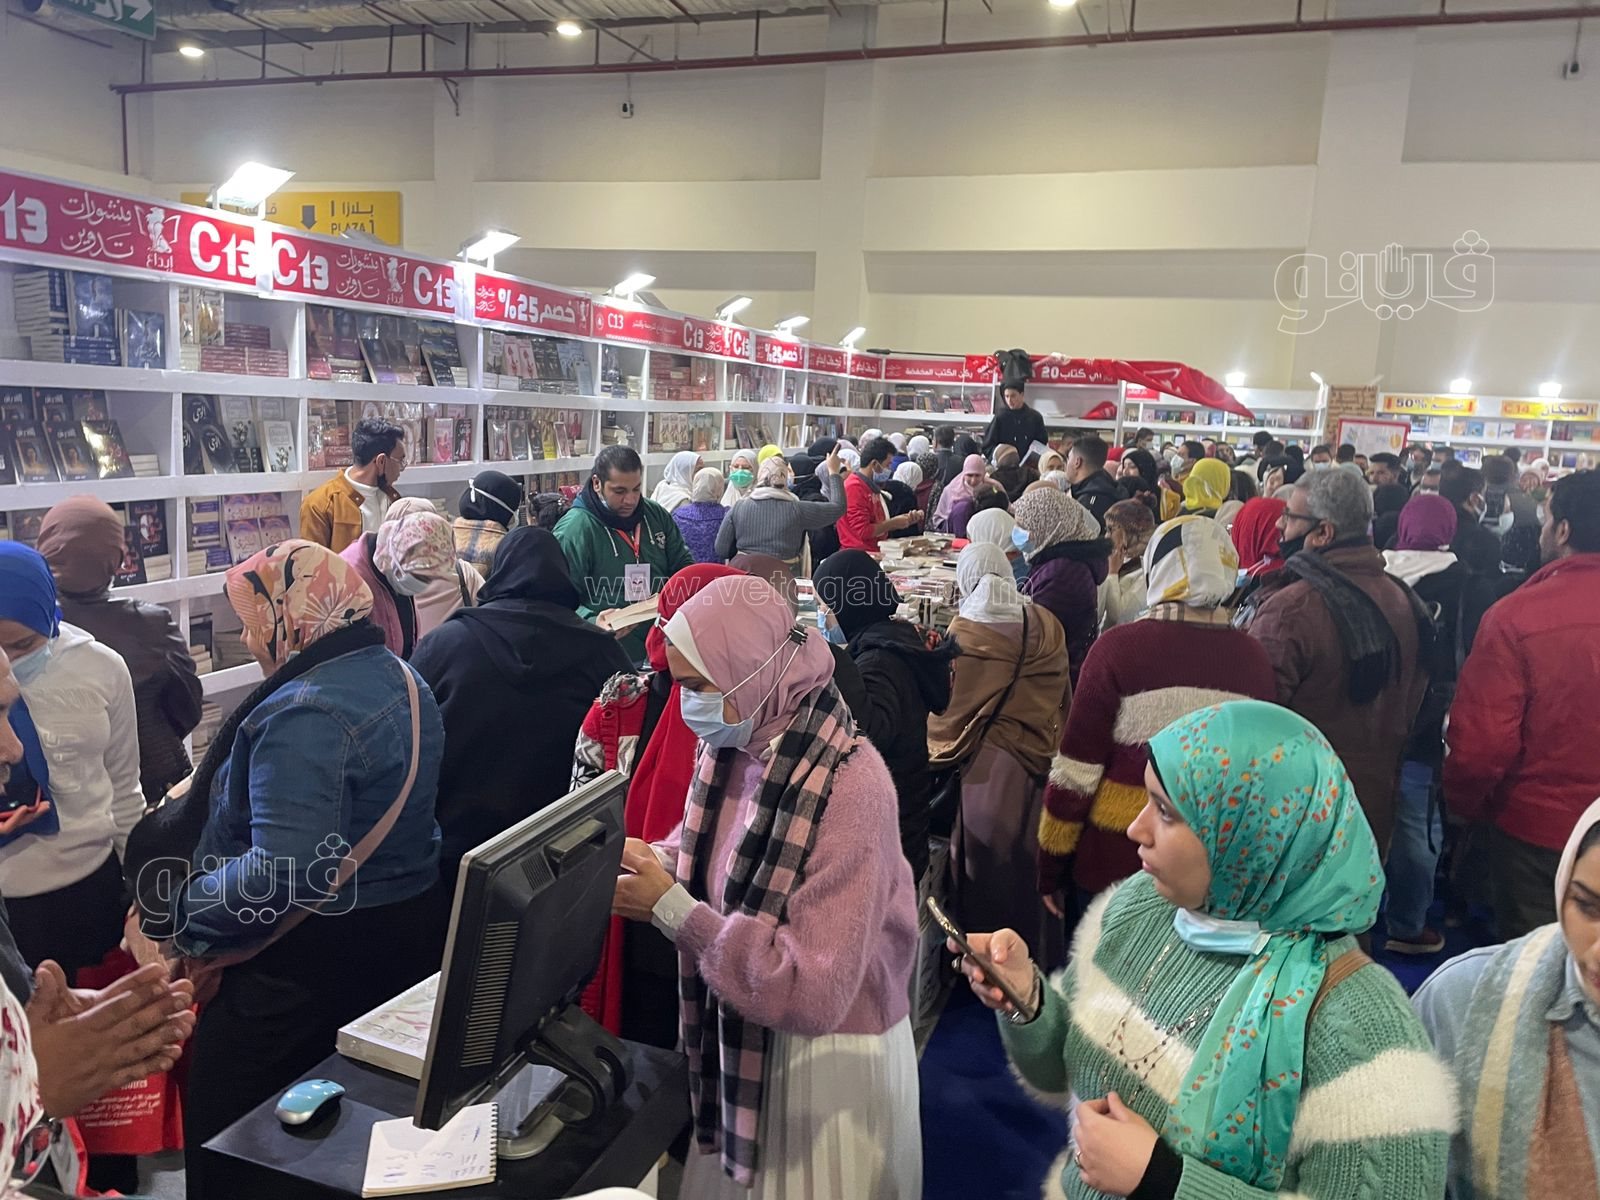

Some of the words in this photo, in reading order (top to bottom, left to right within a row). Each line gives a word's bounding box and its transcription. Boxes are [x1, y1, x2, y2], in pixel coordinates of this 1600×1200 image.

[342, 201, 374, 218] بلازا
[331, 222, 366, 234] PLAZA
[190, 220, 257, 280] C13
[272, 238, 329, 291] C13
[413, 265, 456, 309] C13
[607, 312, 624, 330] C13
[683, 321, 704, 349] C13
[1041, 366, 1059, 379] 20
[1060, 367, 1086, 381] كتاب
